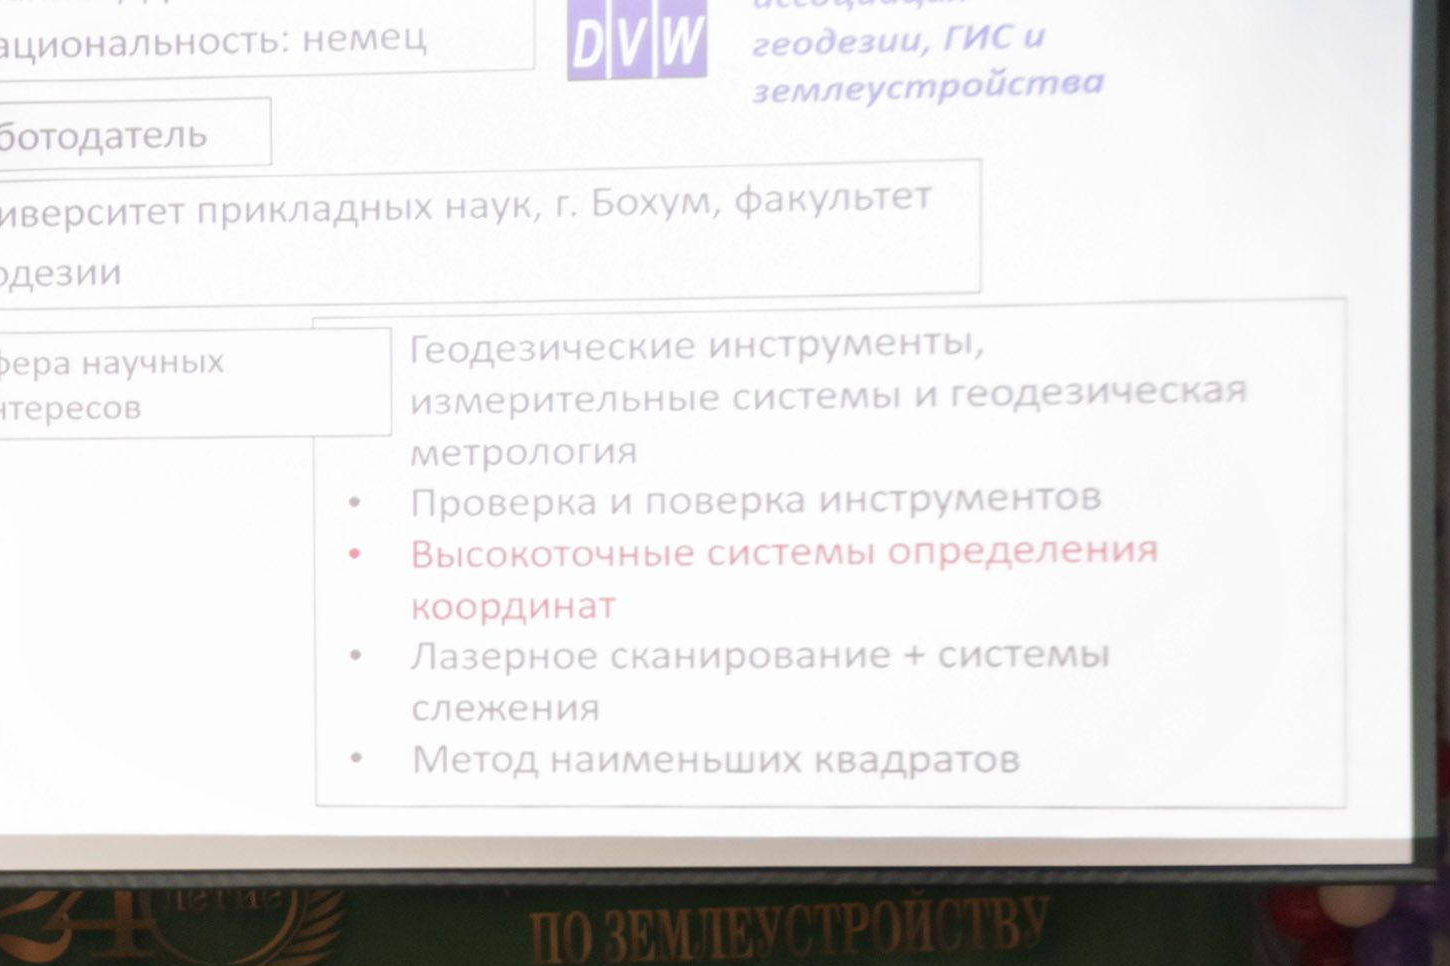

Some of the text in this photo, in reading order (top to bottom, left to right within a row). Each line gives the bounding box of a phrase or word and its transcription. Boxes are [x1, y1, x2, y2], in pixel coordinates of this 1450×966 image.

[304, 28, 427, 56] немец
[572, 15, 706, 68] DVW
[753, 24, 1045, 57] геодезии, ГИС и
[753, 68, 1105, 108] землеустройства
[199, 199, 432, 230] прикладных
[447, 197, 540, 225] наук,
[557, 195, 576, 217] г.
[593, 188, 720, 222] Бохум,
[735, 184, 932, 220] факультет
[83, 354, 224, 381] научных
[412, 333, 983, 369] Геодезические инструменты,
[412, 380, 1246, 420] измерительные системы и геодезическая
[411, 443, 636, 472] метрология
[413, 487, 1102, 523] Проверка и поверка инструментов
[413, 540, 1157, 571] Высокоточные системы определения
[413, 597, 616, 626] координат
[410, 642, 1109, 676] Лазерное сканирование + системы
[413, 700, 598, 722] слежения
[414, 745, 1020, 780] Метод наименьших квадратов
[528, 889, 1050, 966] ПО ЗЕМЛЕУСТРОЙСТВУ
